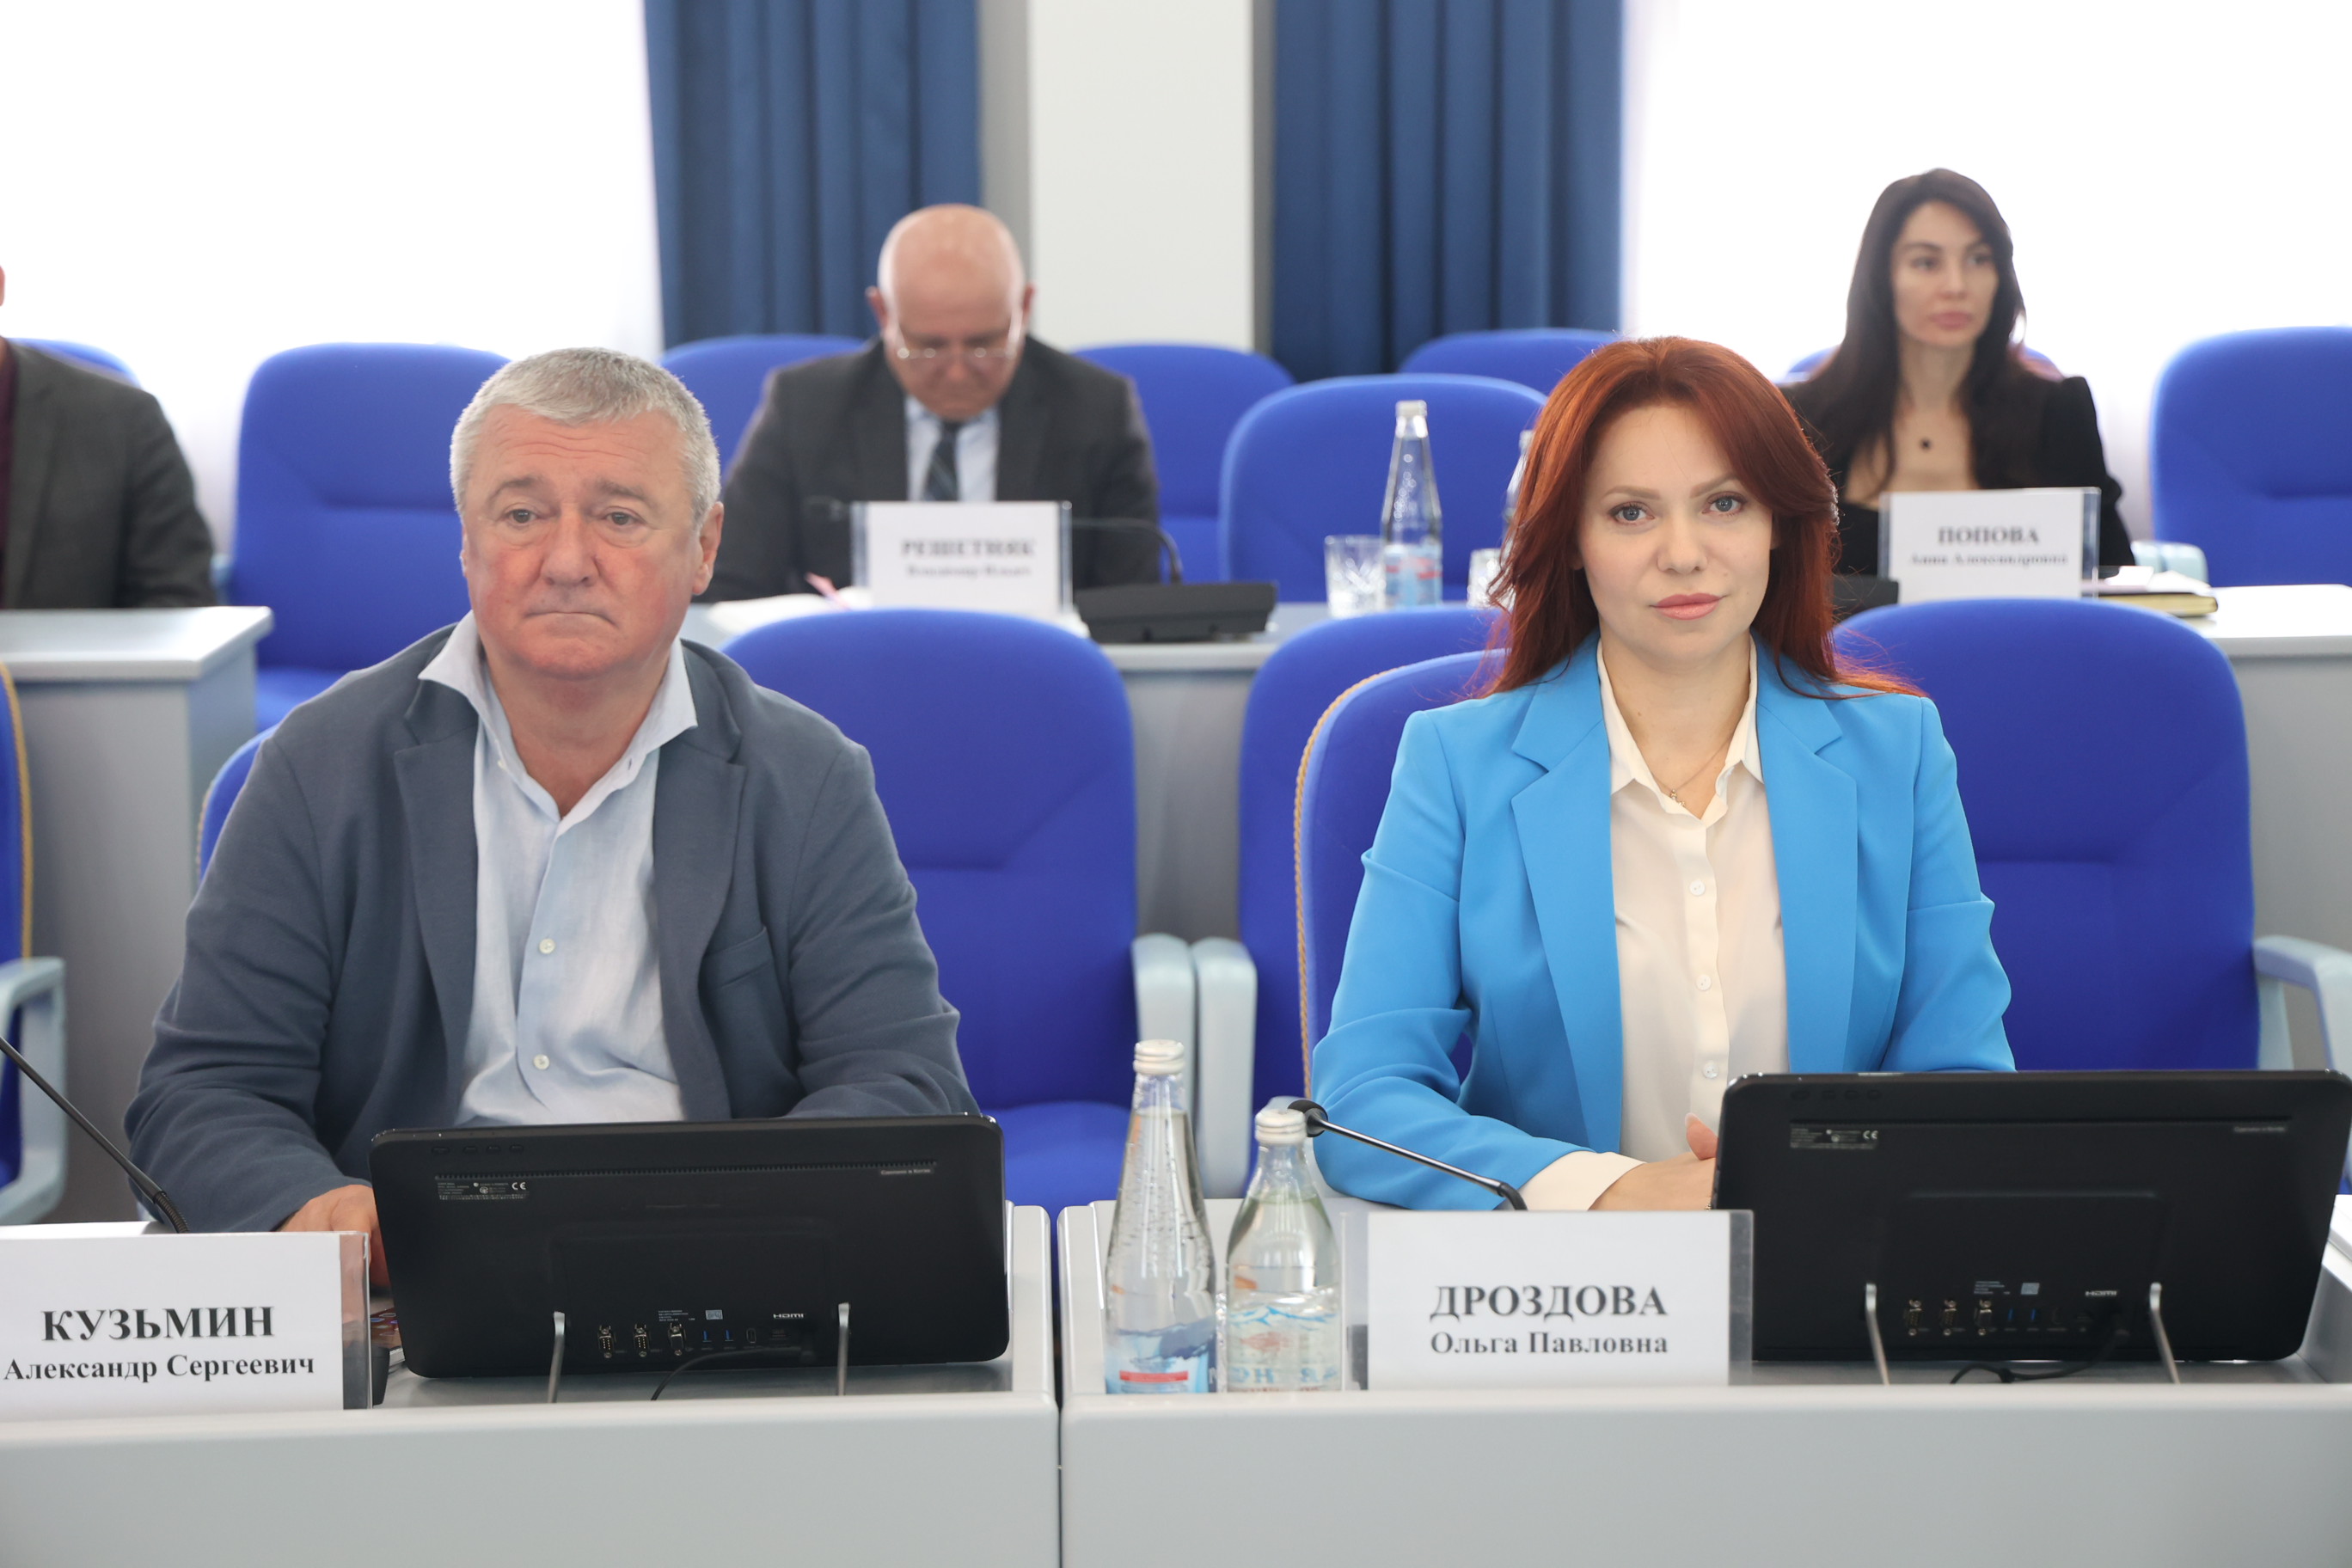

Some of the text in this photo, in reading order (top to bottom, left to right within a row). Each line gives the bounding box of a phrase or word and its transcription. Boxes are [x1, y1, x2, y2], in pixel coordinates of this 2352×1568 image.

[1937, 525, 2040, 545] ПОПОВА
[1430, 1285, 1668, 1322] ДРОЗДОВА
[41, 1306, 274, 1342] КУЗЬМИН
[1430, 1332, 1668, 1354] Ольга Павловна
[4, 1354, 314, 1383] Александр Сергеевич
